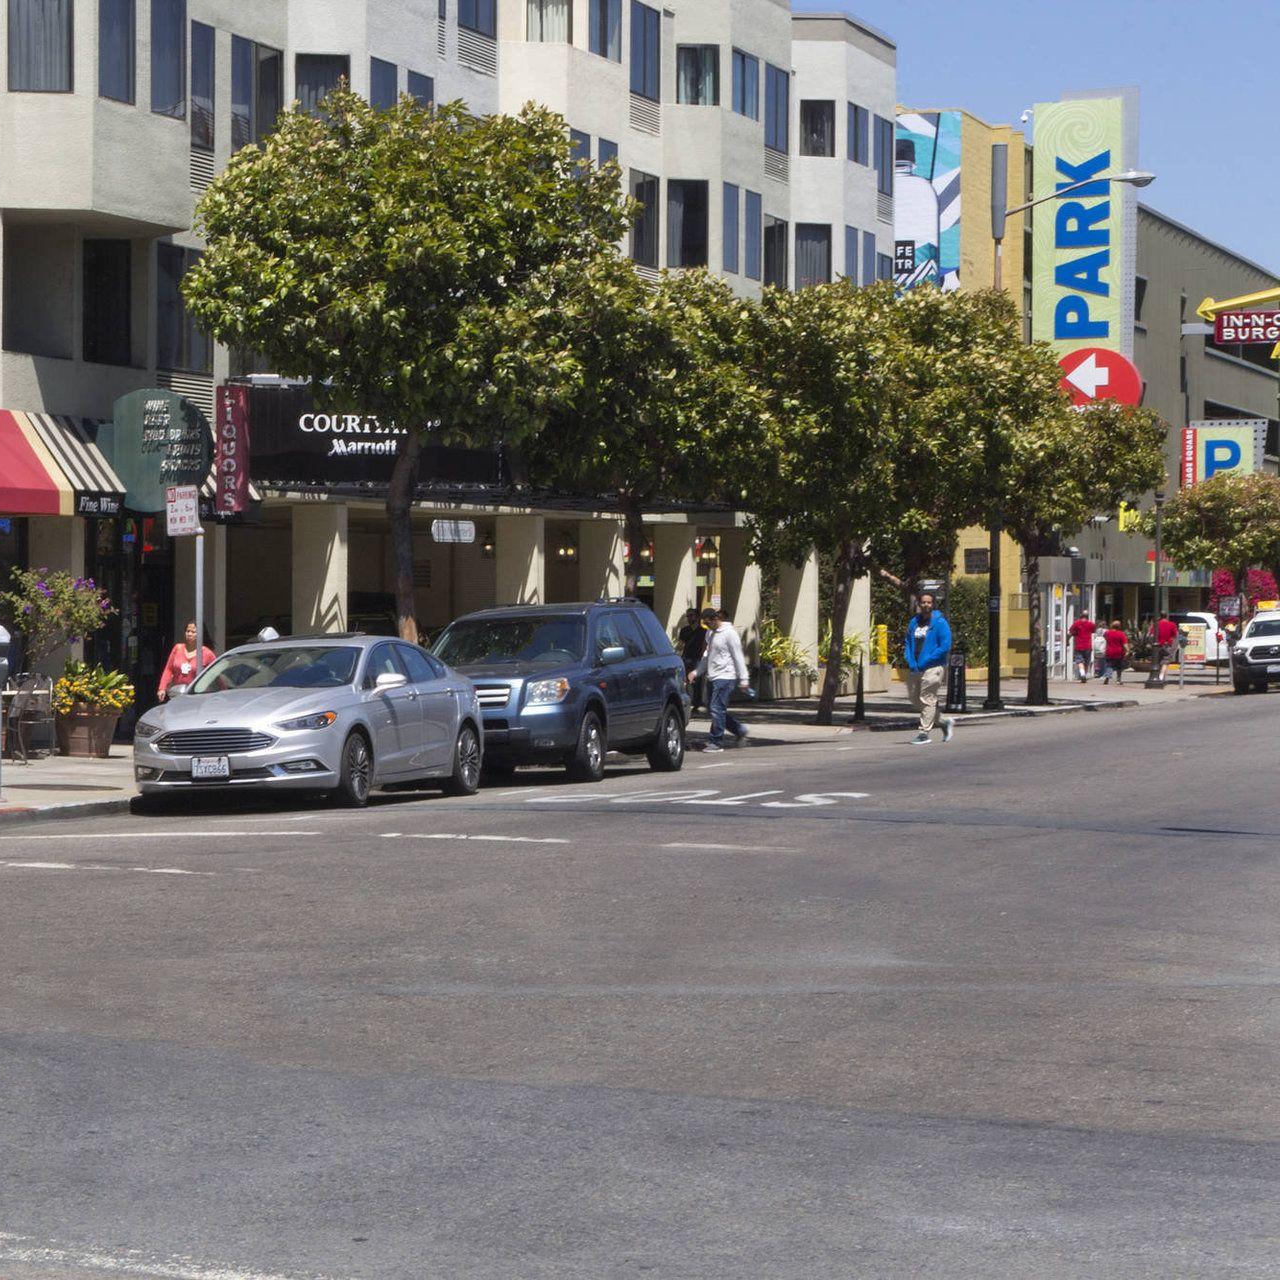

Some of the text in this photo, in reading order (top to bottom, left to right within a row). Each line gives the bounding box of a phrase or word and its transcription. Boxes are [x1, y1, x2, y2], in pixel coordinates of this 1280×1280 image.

[1055, 149, 1110, 340] PARK
[222, 391, 237, 506] LIQUORS
[327, 439, 397, 457] Marriott
[1205, 440, 1241, 480] P
[79, 496, 99, 512] Fine
